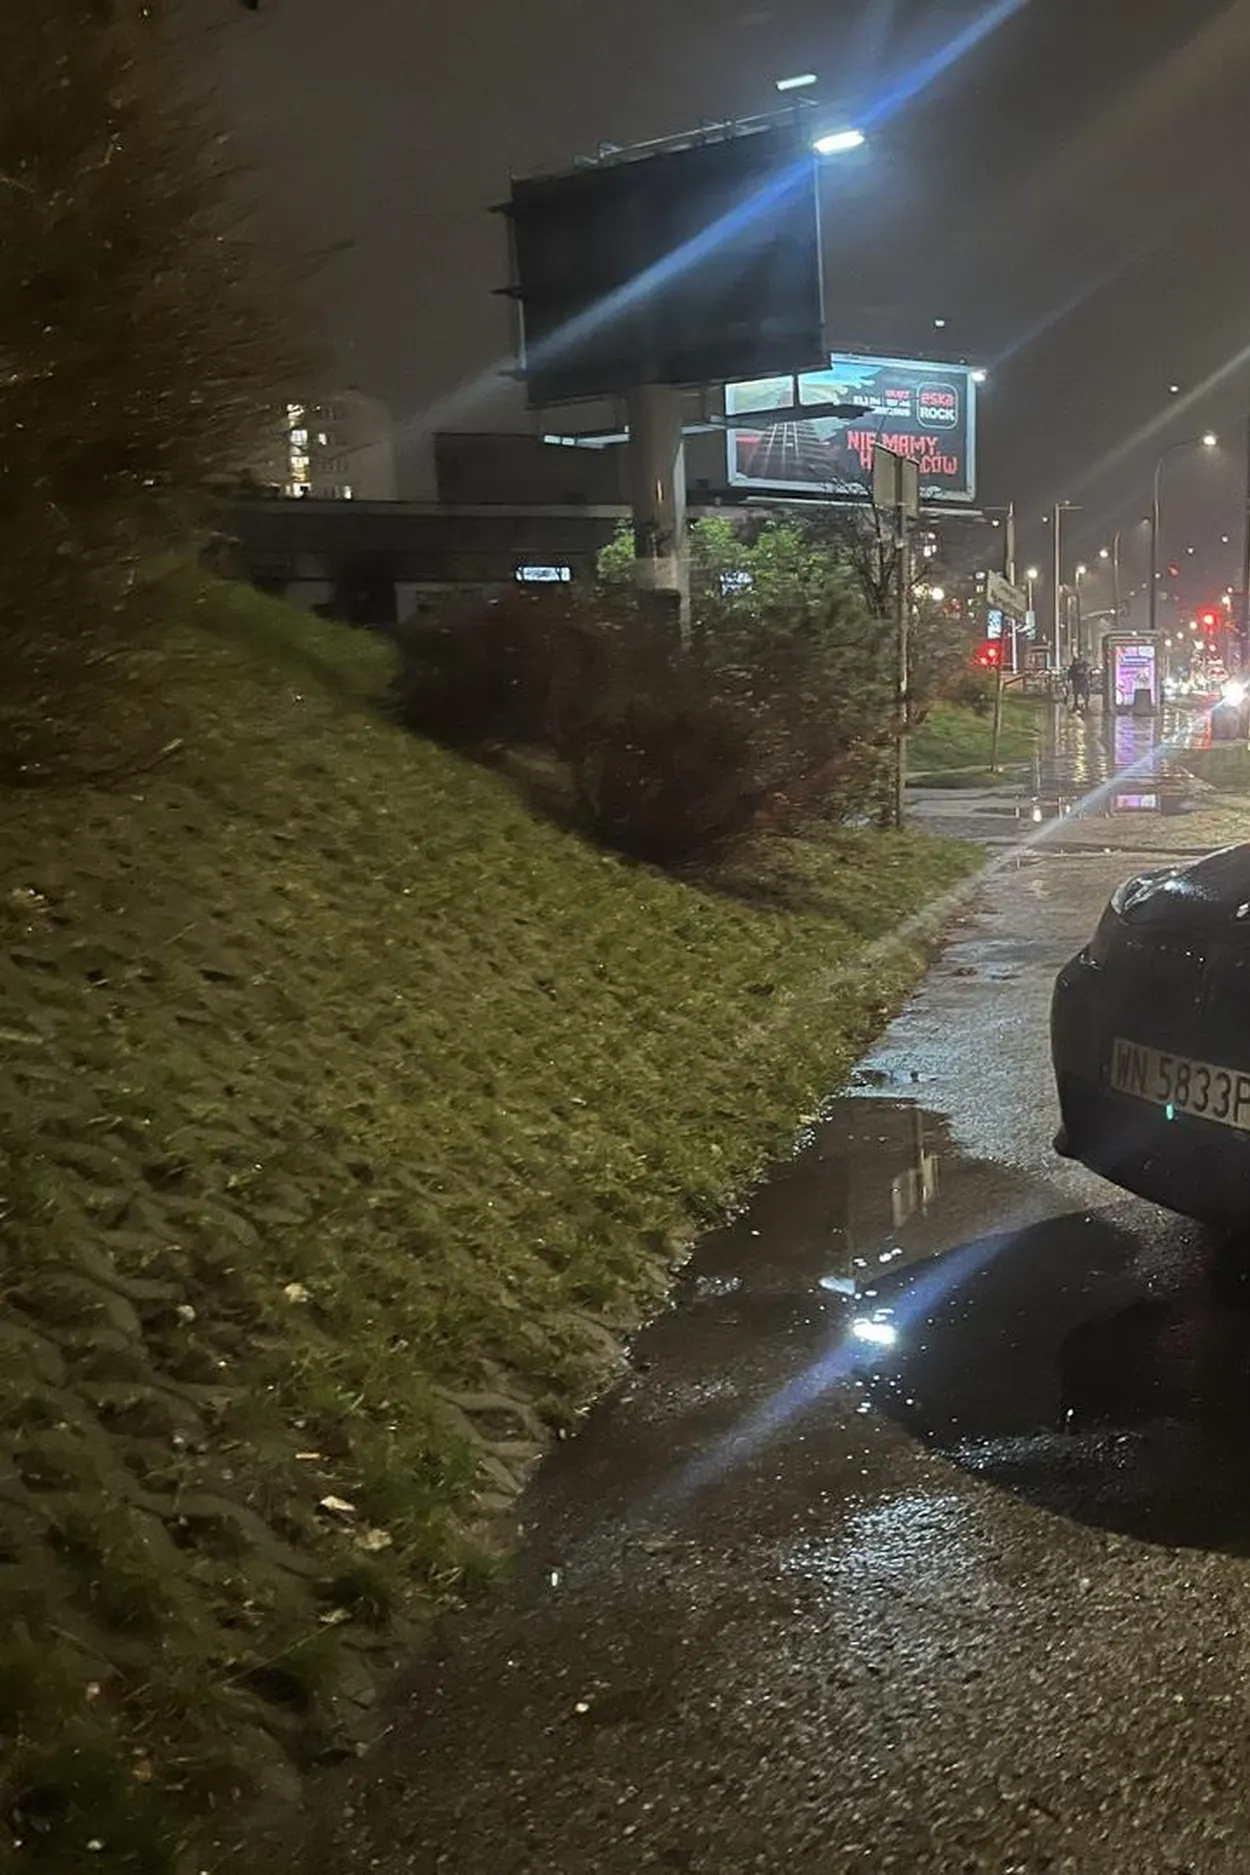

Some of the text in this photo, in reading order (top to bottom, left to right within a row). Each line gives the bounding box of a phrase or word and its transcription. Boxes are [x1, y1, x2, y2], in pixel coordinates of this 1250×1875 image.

[920, 406, 955, 421] ROCK
[847, 430, 938, 457] NIE MAMY
[1115, 1042, 1148, 1096] WN
